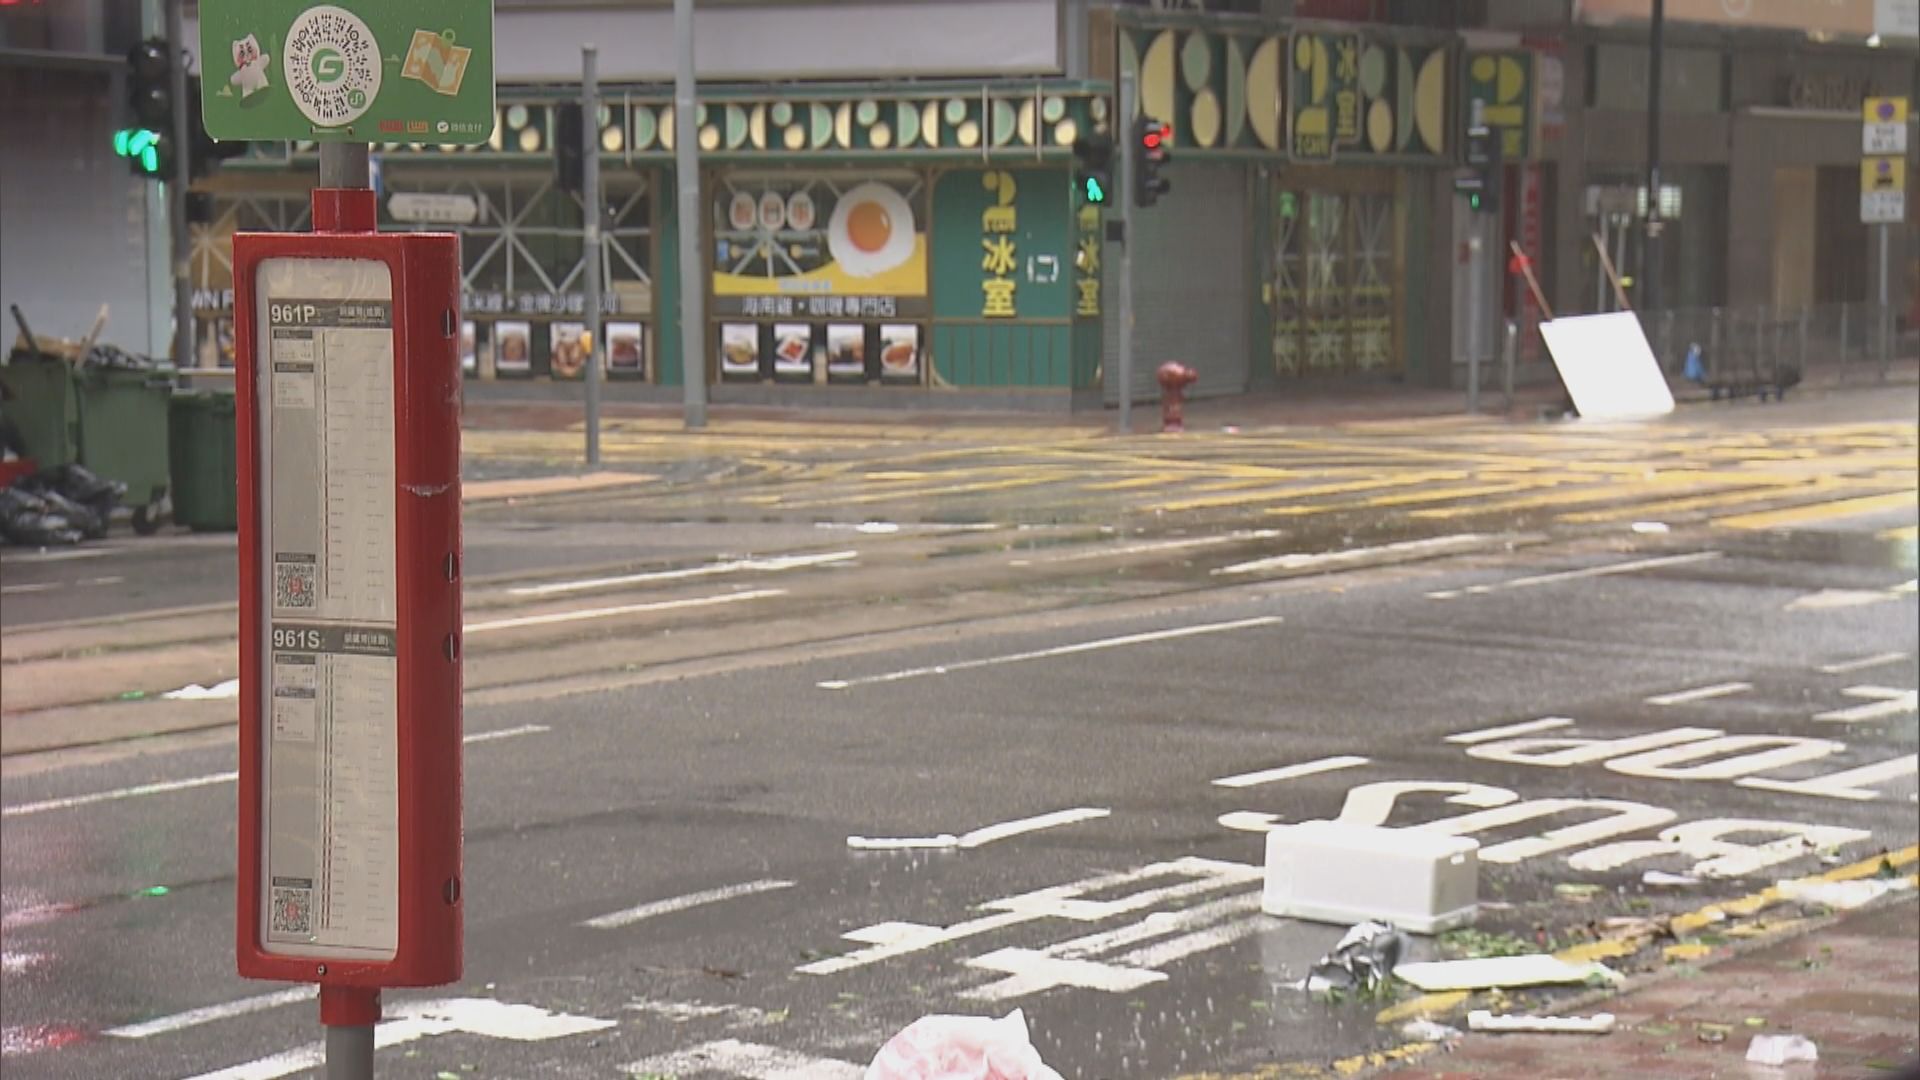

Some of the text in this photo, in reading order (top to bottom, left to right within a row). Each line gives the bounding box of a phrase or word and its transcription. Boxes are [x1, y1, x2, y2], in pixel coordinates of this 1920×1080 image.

[271, 303, 316, 324] 961P
[273, 629, 321, 649] 961S
[1465, 727, 1918, 803] TOP
[1217, 780, 1872, 877] BUS
